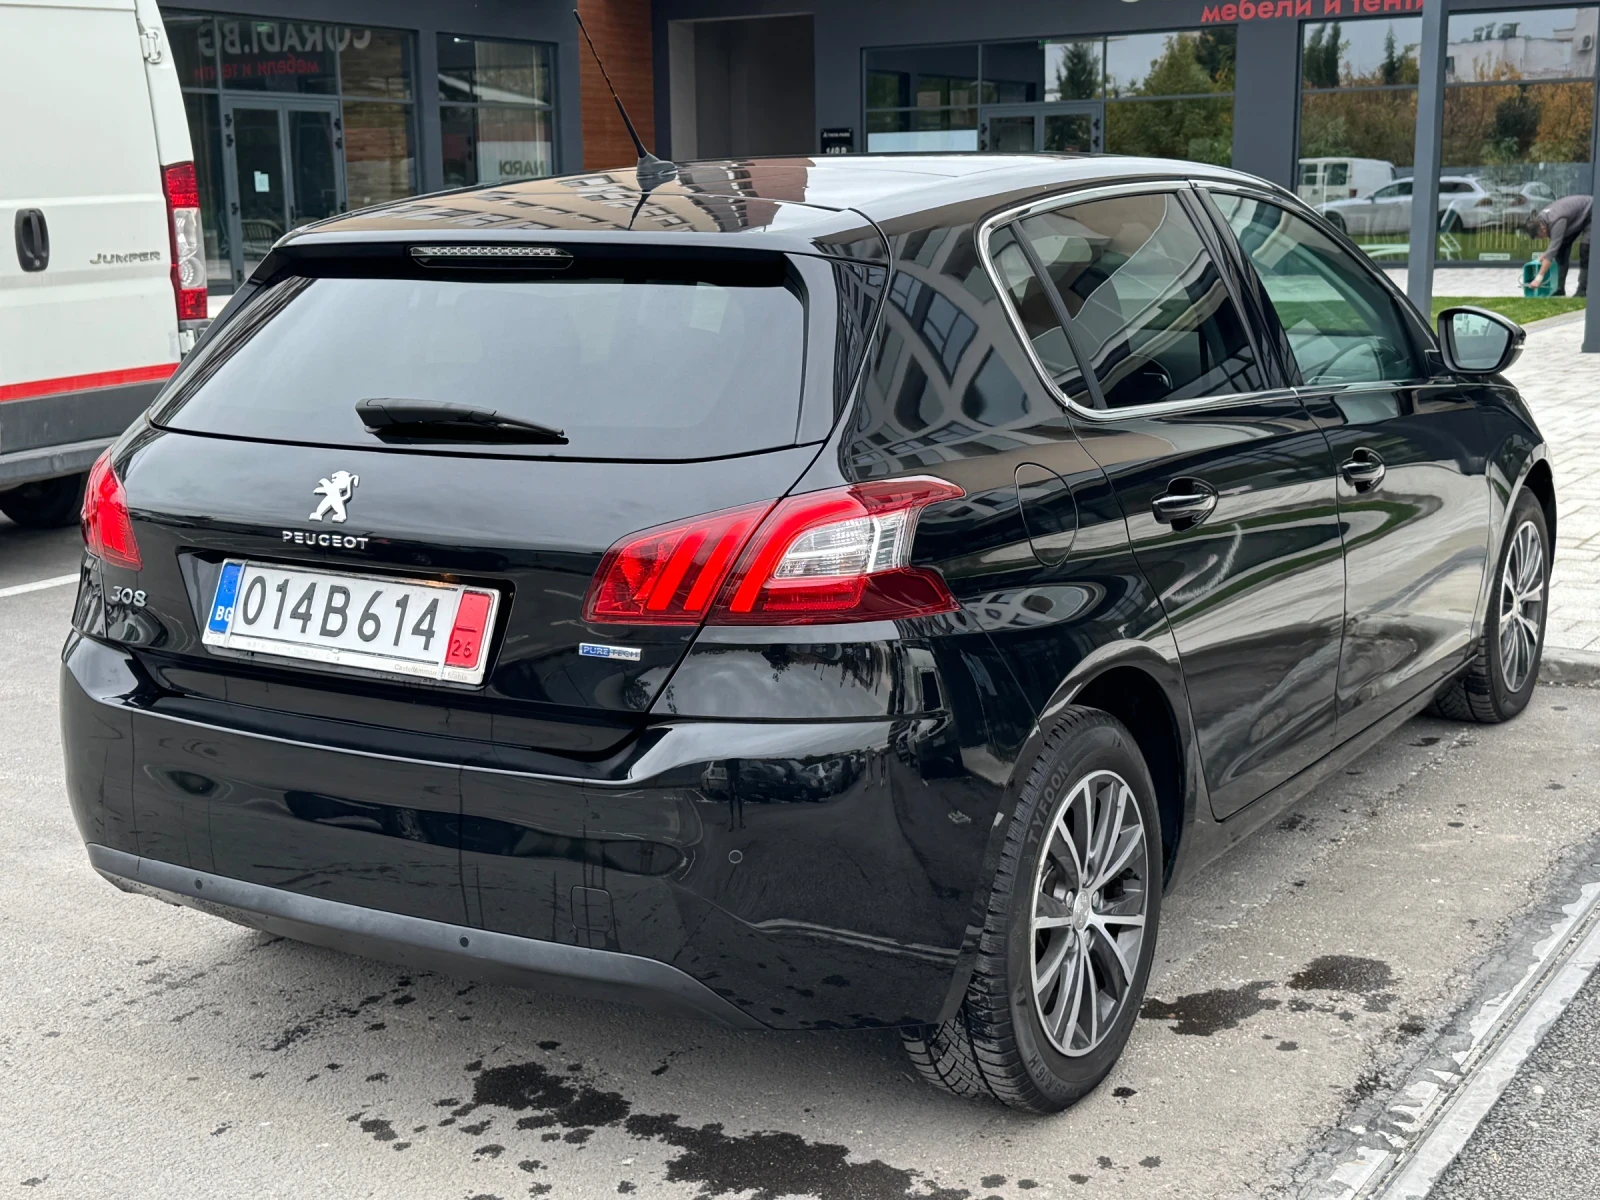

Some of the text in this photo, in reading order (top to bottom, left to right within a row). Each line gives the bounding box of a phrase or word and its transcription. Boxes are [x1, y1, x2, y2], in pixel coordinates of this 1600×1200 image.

[1201, 0, 1311, 22] мебели
[89, 251, 160, 264] JUMPER
[282, 530, 369, 549] PEUGEOT
[111, 585, 146, 607] 308
[215, 605, 233, 622] BG
[242, 575, 440, 651] 014B614
[451, 639, 473, 659] 26
[1028, 760, 1069, 844] TYFOON
